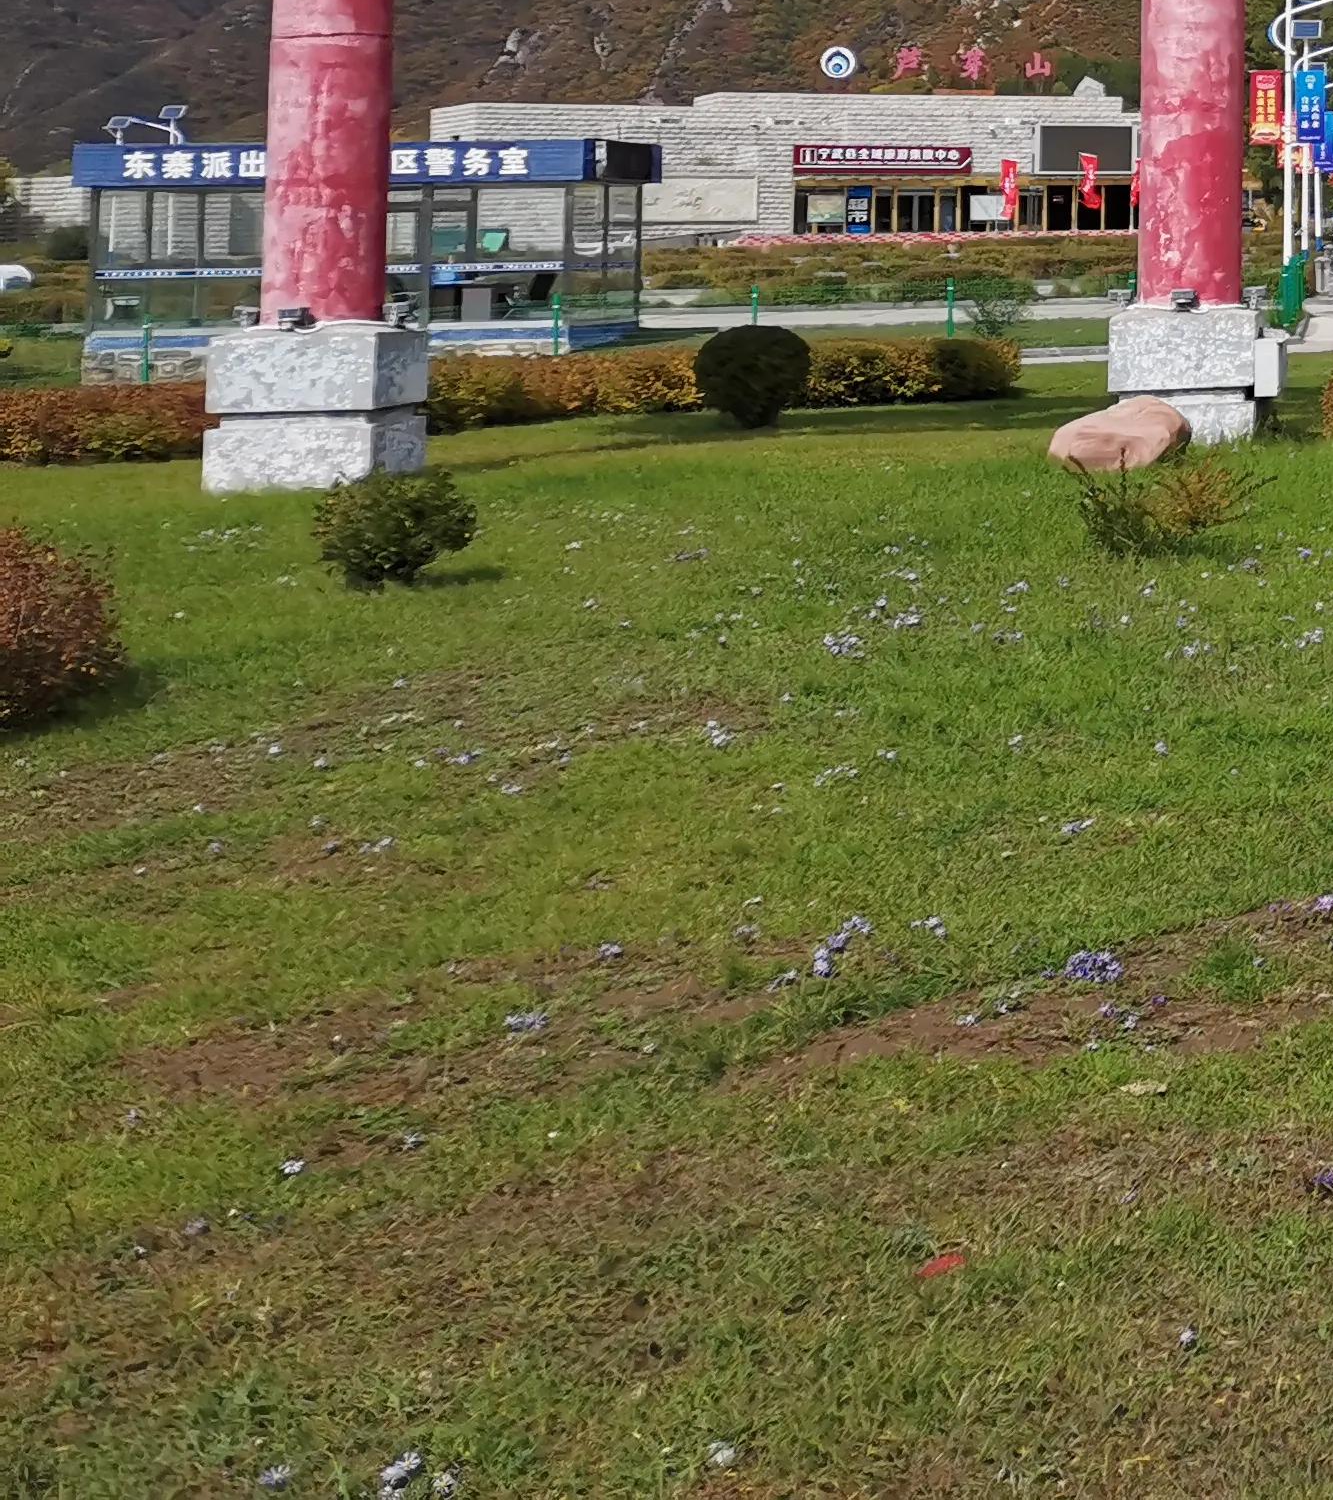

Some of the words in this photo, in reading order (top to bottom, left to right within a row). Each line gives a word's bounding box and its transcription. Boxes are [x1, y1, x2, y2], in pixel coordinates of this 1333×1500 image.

[122, 150, 266, 179] 东寨派出
[391, 148, 529, 176] 区警务室
